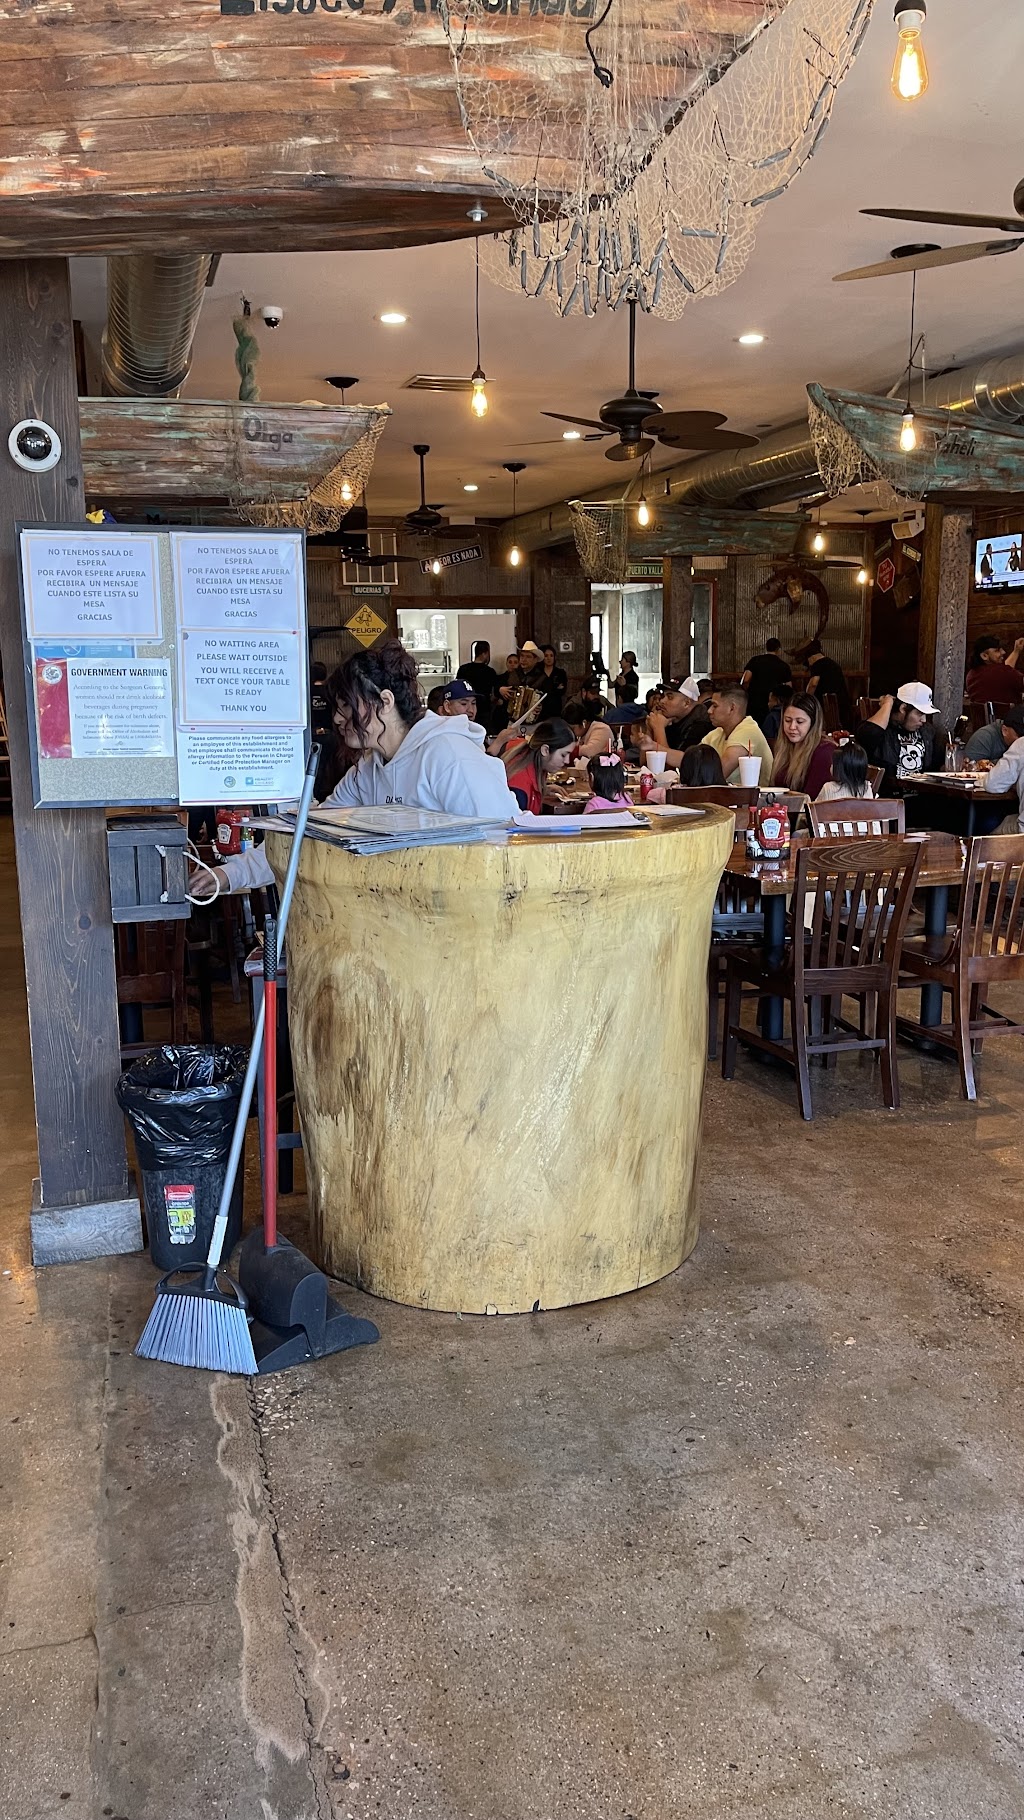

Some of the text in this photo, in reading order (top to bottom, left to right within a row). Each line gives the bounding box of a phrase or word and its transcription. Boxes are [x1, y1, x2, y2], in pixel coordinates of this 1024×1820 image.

[243, 415, 293, 452] Olga
[452, 553, 460, 563] ES
[461, 549, 478, 560] NADA
